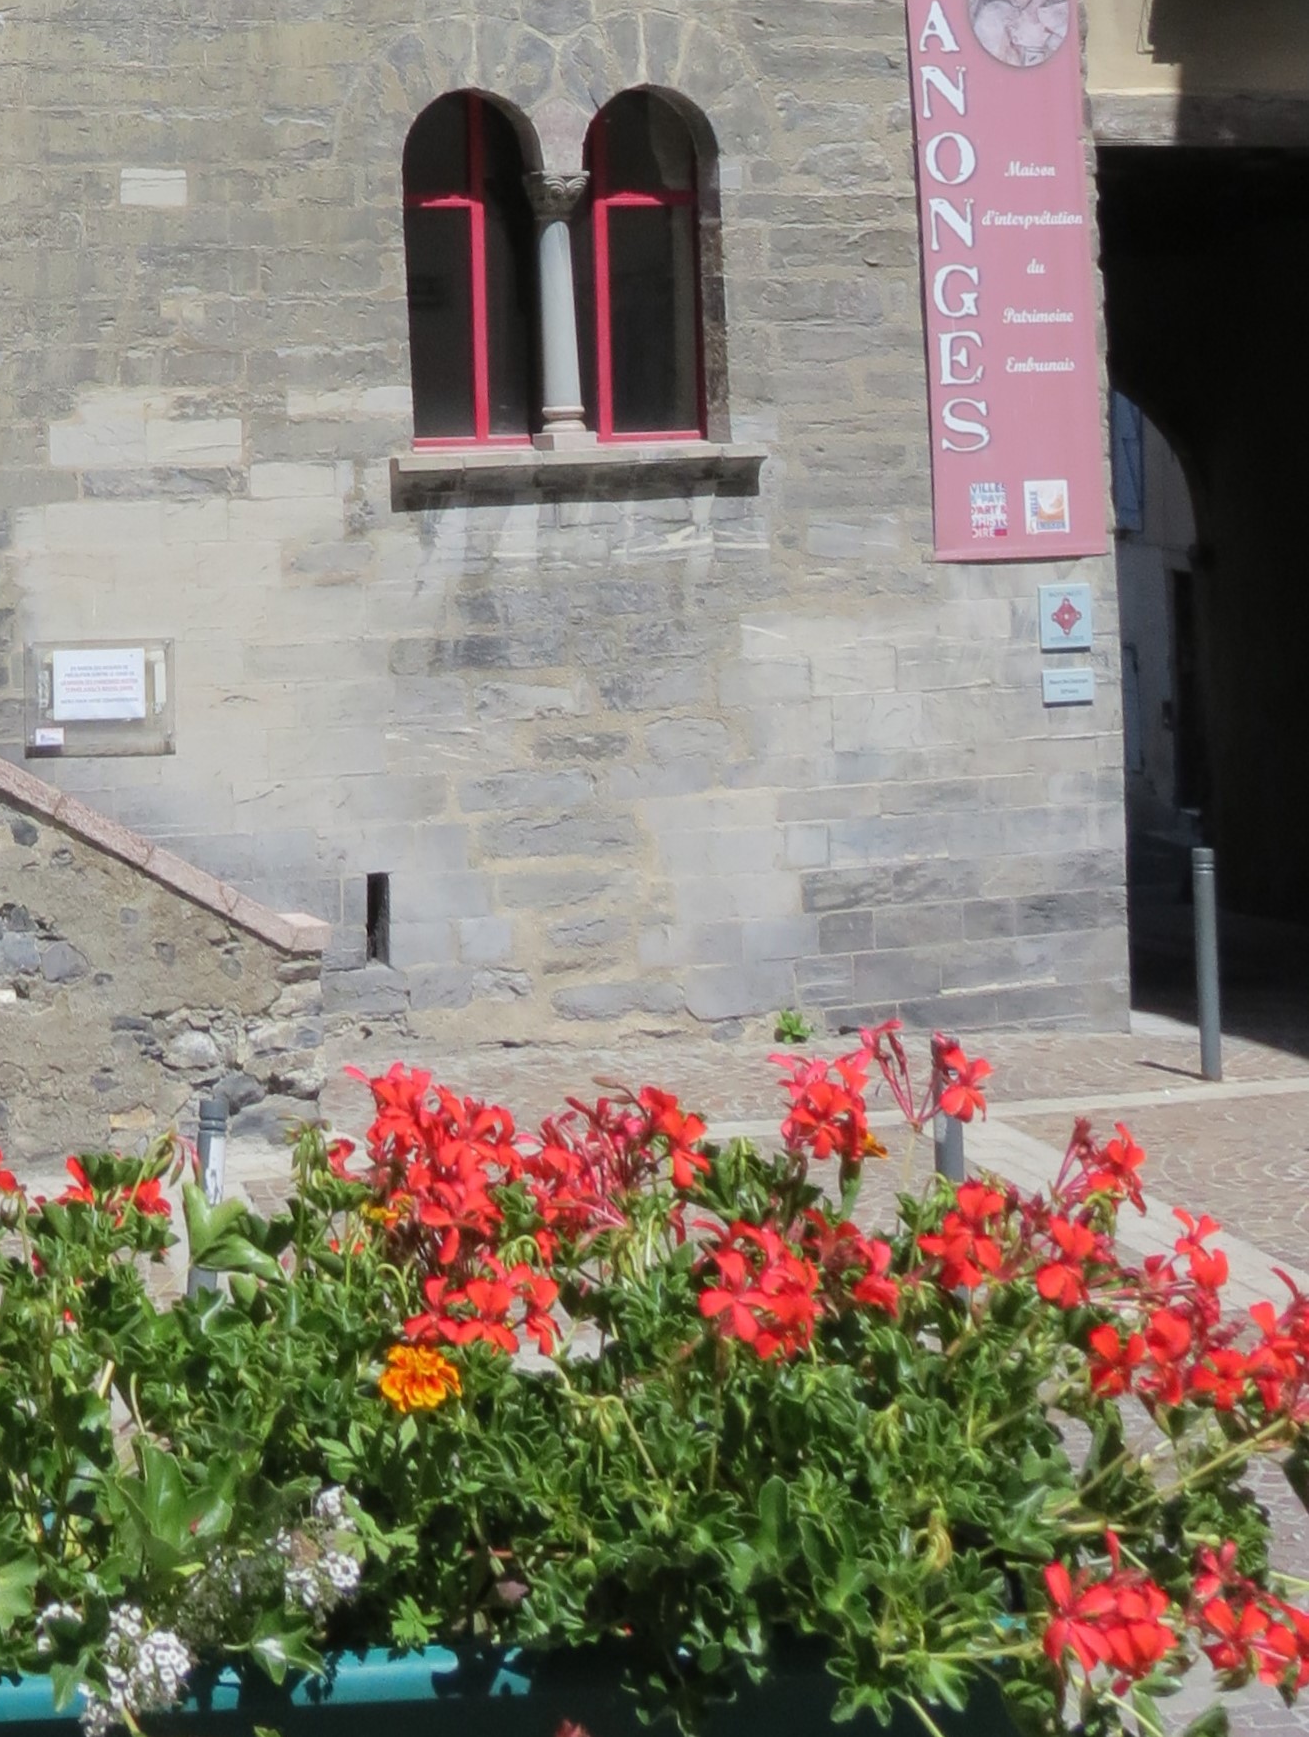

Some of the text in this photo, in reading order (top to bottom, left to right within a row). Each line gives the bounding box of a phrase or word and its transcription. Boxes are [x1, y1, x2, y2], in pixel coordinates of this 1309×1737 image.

[1004, 161, 1056, 177] Maison
[1026, 258, 1046, 275] du
[1002, 307, 1074, 323] Patrimoine
[1005, 356, 1075, 373] Embrunais
